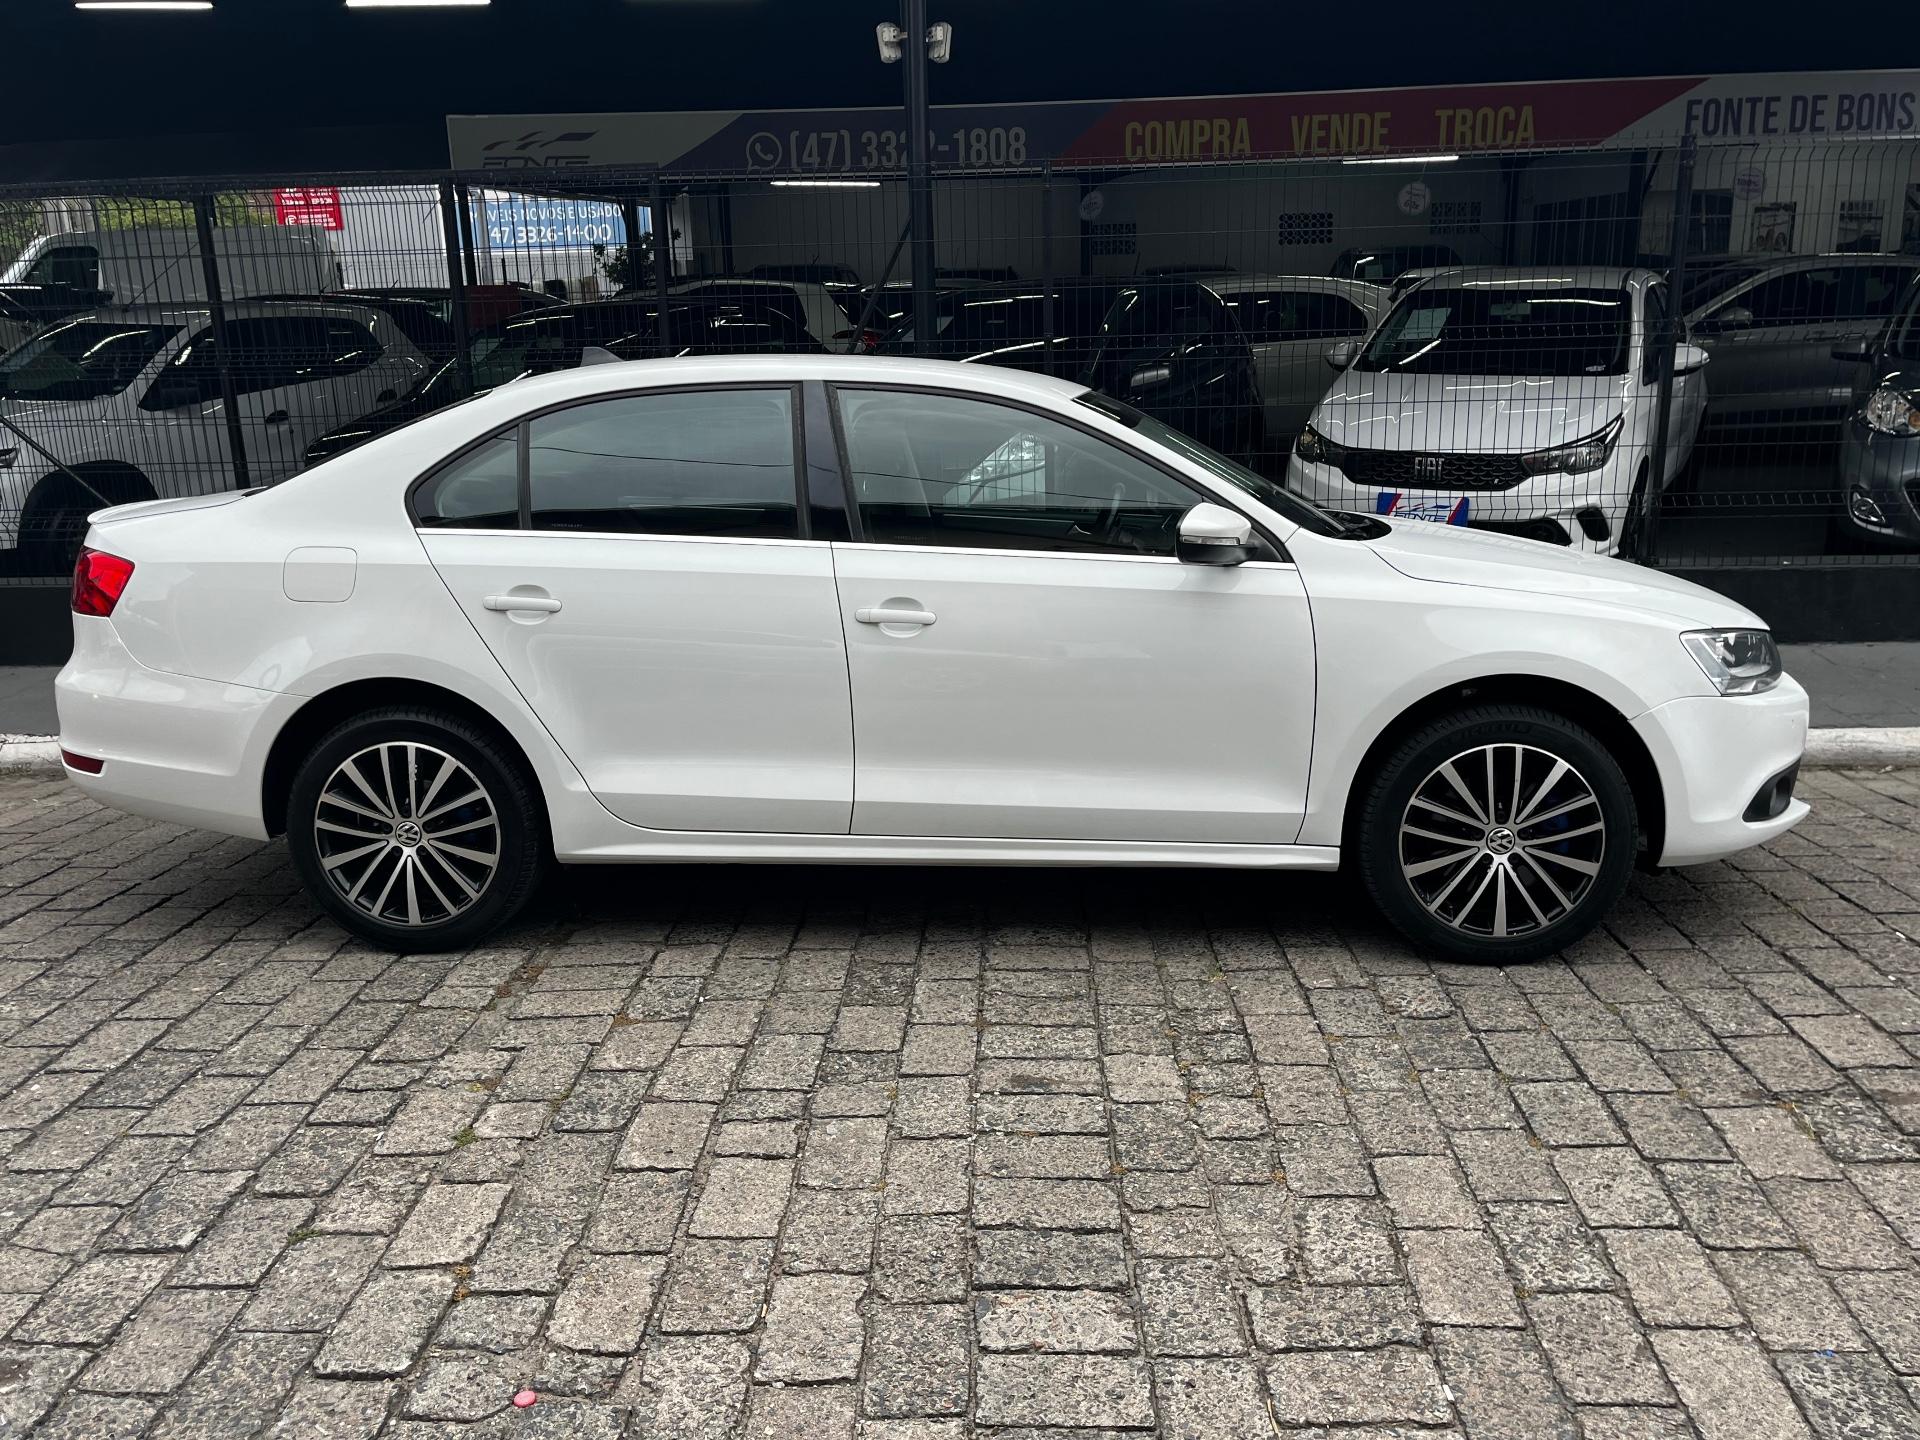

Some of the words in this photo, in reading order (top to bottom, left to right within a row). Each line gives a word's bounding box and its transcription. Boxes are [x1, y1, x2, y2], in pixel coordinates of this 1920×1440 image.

[1124, 117, 1251, 161] COMPRA
[1291, 112, 1391, 154] VENDE
[1434, 105, 1535, 147] TROCA
[1684, 96, 1782, 137] FONTE
[1789, 94, 1829, 133] DE
[1835, 91, 1916, 131] BONS
[789, 129, 851, 172] (47)
[578, 204, 625, 219] USADO
[1414, 457, 1445, 480] FIAT
